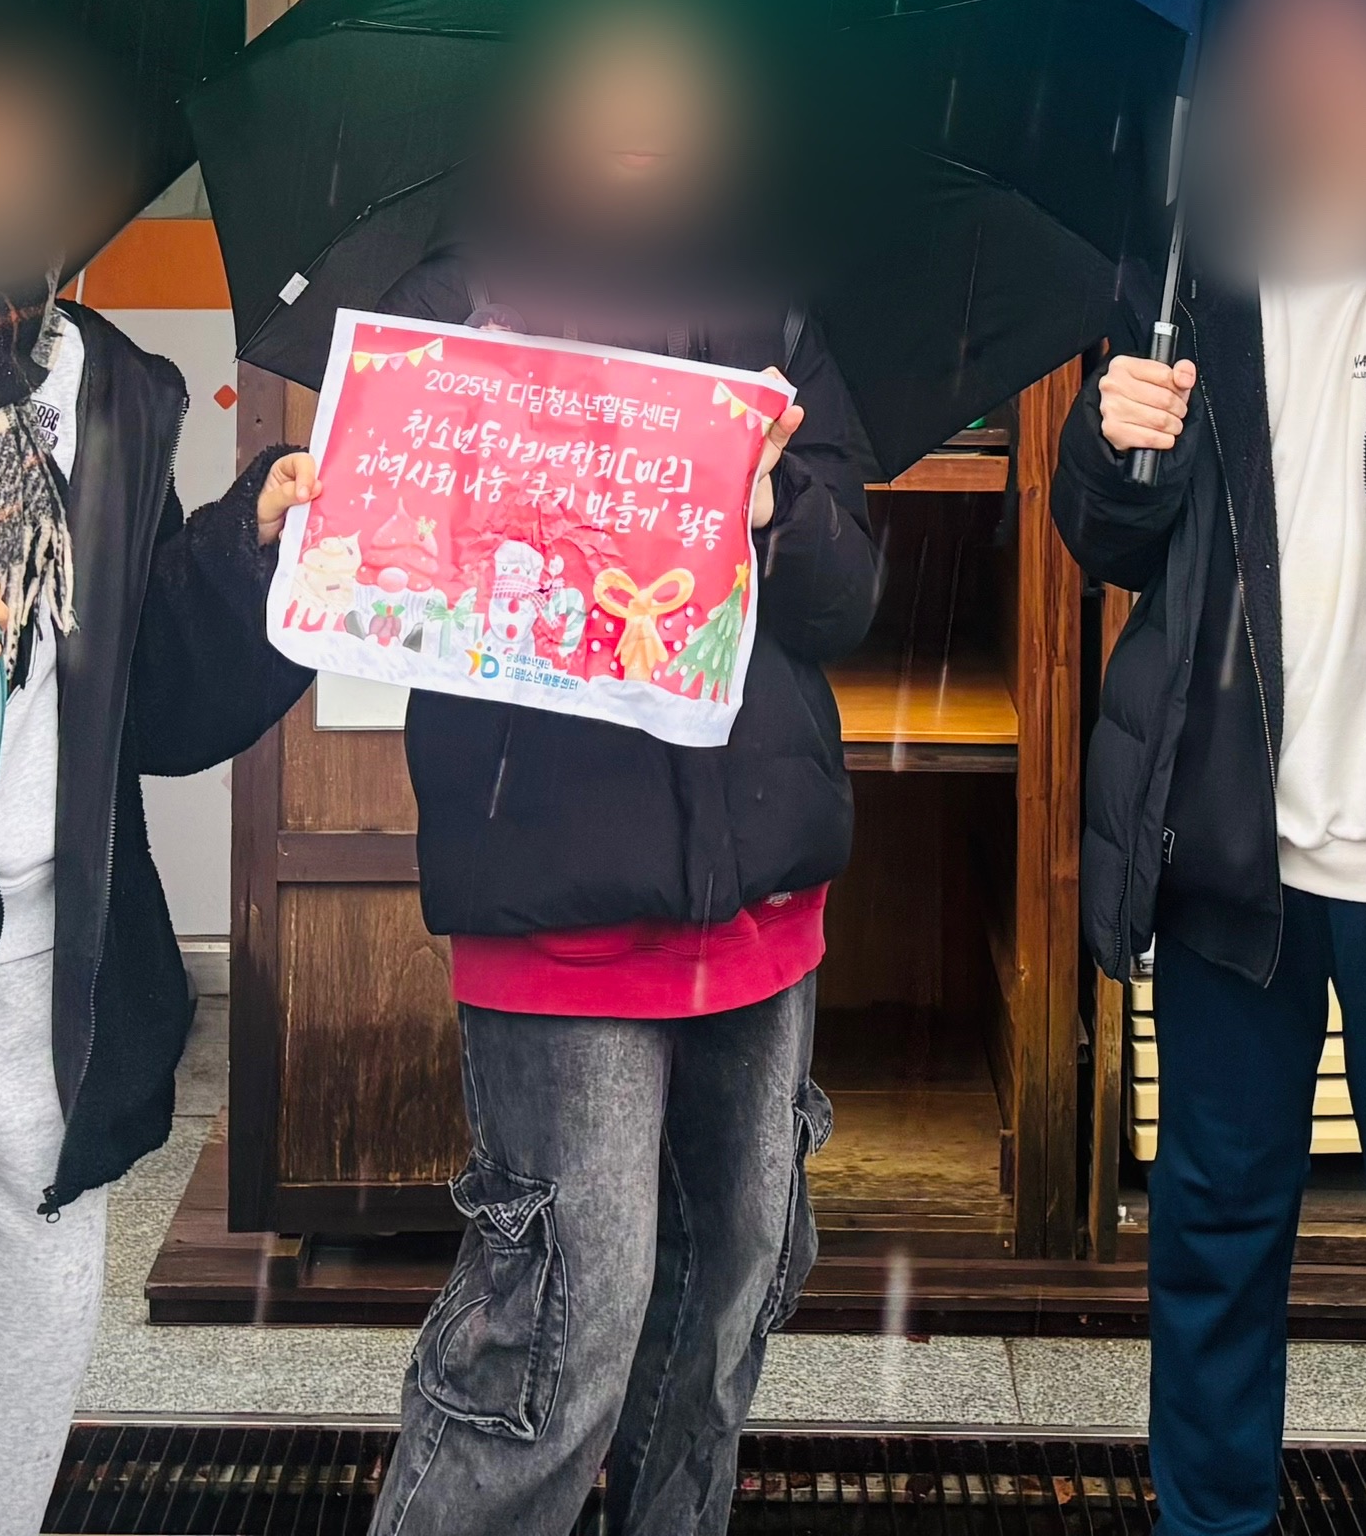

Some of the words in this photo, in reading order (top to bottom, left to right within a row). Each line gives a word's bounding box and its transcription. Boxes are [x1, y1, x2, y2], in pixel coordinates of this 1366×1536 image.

[425, 369, 503, 403] 2025년
[506, 383, 682, 432] 디딤청소년활동센터
[402, 408, 692, 493] 청소년동아리연합회[미르]
[355, 452, 457, 497] 지역사회
[463, 464, 510, 504] 나눔
[676, 502, 725, 551] 활동
